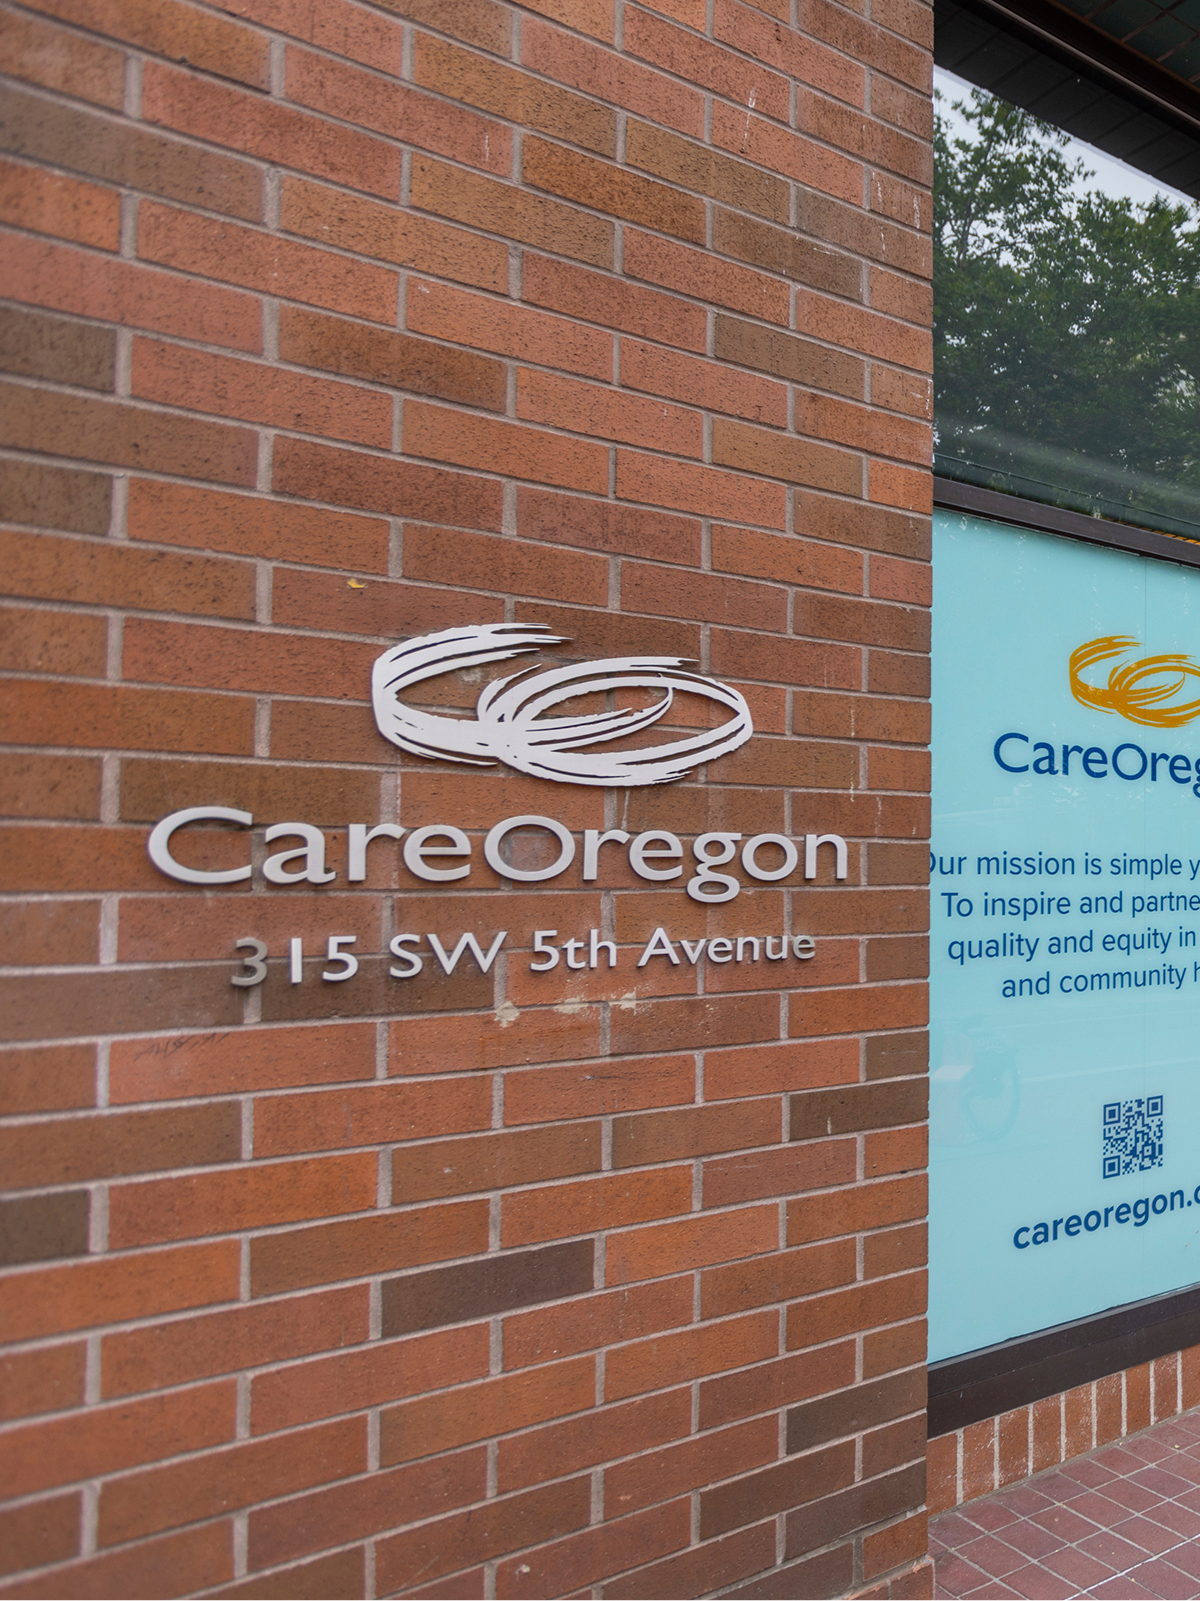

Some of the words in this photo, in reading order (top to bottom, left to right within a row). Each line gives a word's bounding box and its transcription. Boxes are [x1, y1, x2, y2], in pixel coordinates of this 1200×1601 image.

[146, 805, 849, 903] CareOregon
[977, 850, 1075, 875] mission
[1084, 851, 1102, 875] is
[1110, 853, 1183, 880] simple
[940, 892, 974, 917] To
[984, 891, 1071, 921] inspire
[1079, 890, 1123, 914] and
[230, 934, 360, 988] 315
[388, 931, 508, 979] SW
[529, 928, 618, 972] 5th
[637, 927, 817, 968] Avenue
[947, 932, 1040, 966] quality
[1048, 929, 1093, 955] and
[1102, 926, 1172, 956] equity
[1179, 925, 1196, 947] in
[1002, 971, 1050, 998] and
[1059, 963, 1187, 994] community
